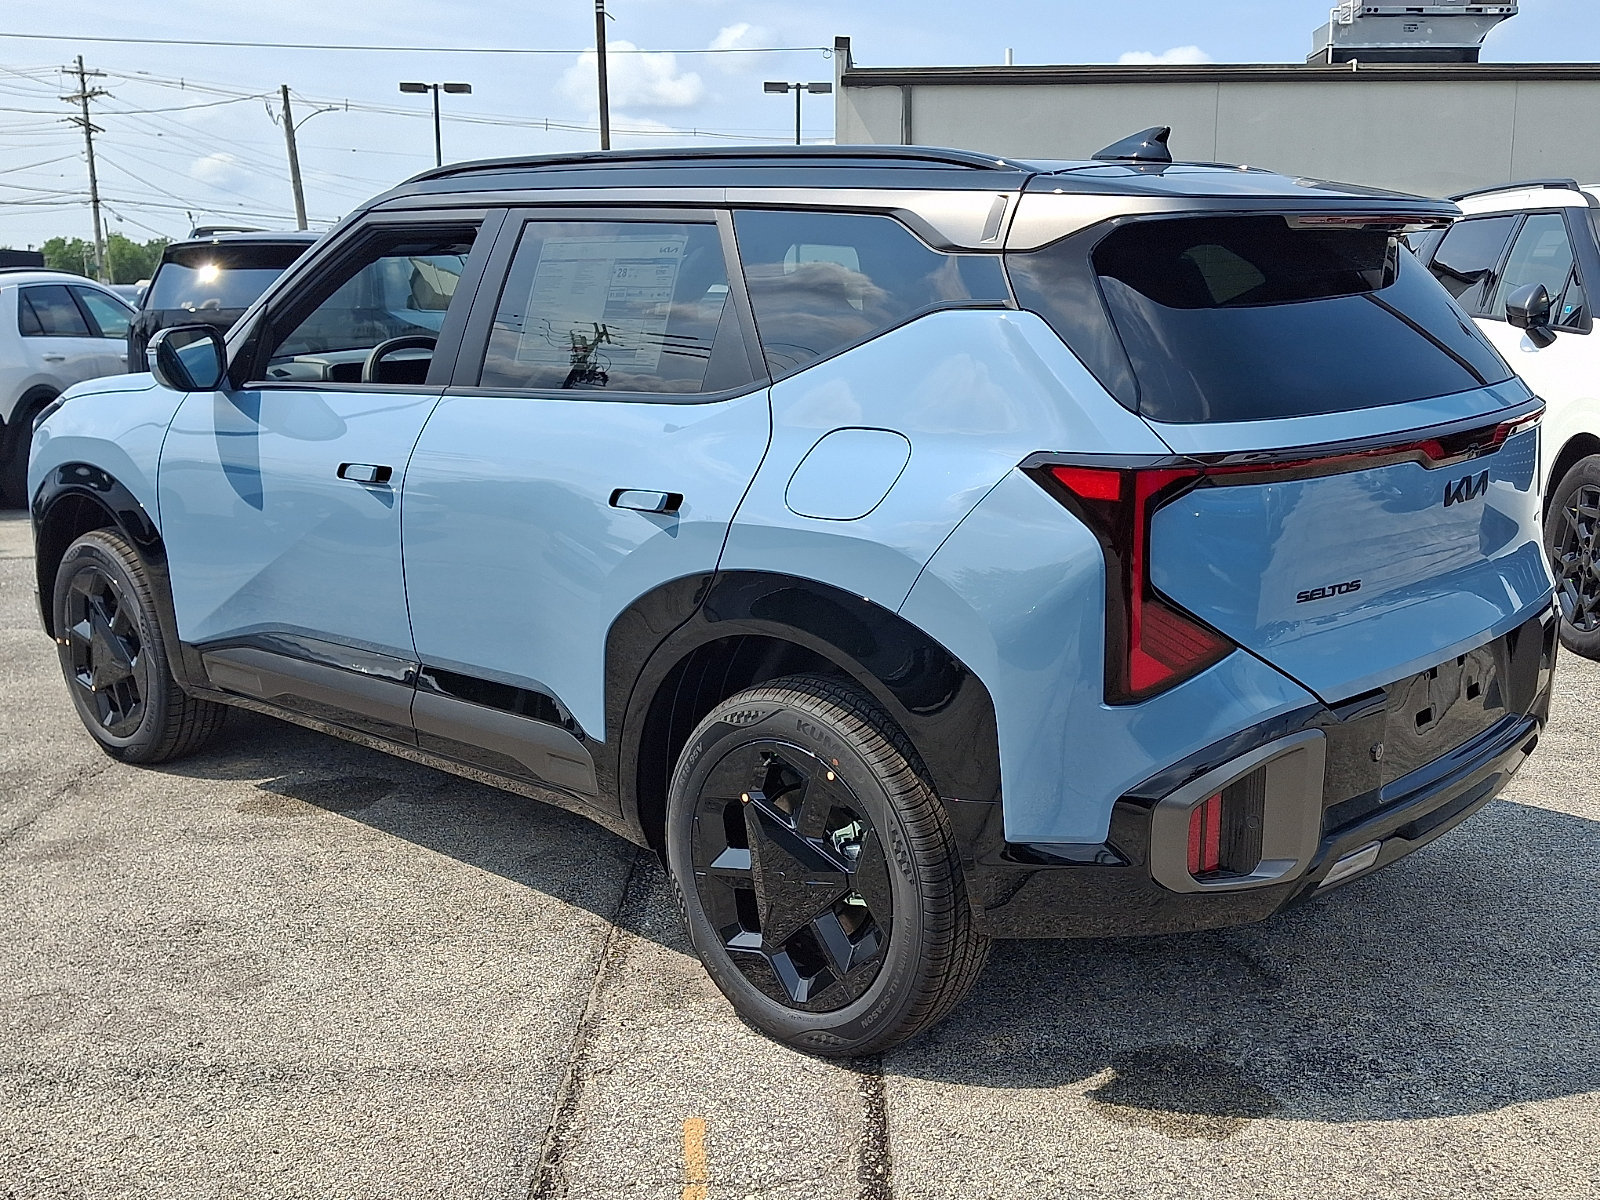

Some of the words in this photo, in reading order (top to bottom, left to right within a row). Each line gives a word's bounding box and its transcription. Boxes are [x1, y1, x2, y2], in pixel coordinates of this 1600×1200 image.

[616, 267, 628, 279] 28
[1443, 469, 1489, 508] KIA
[1296, 579, 1361, 604] SELTOS
